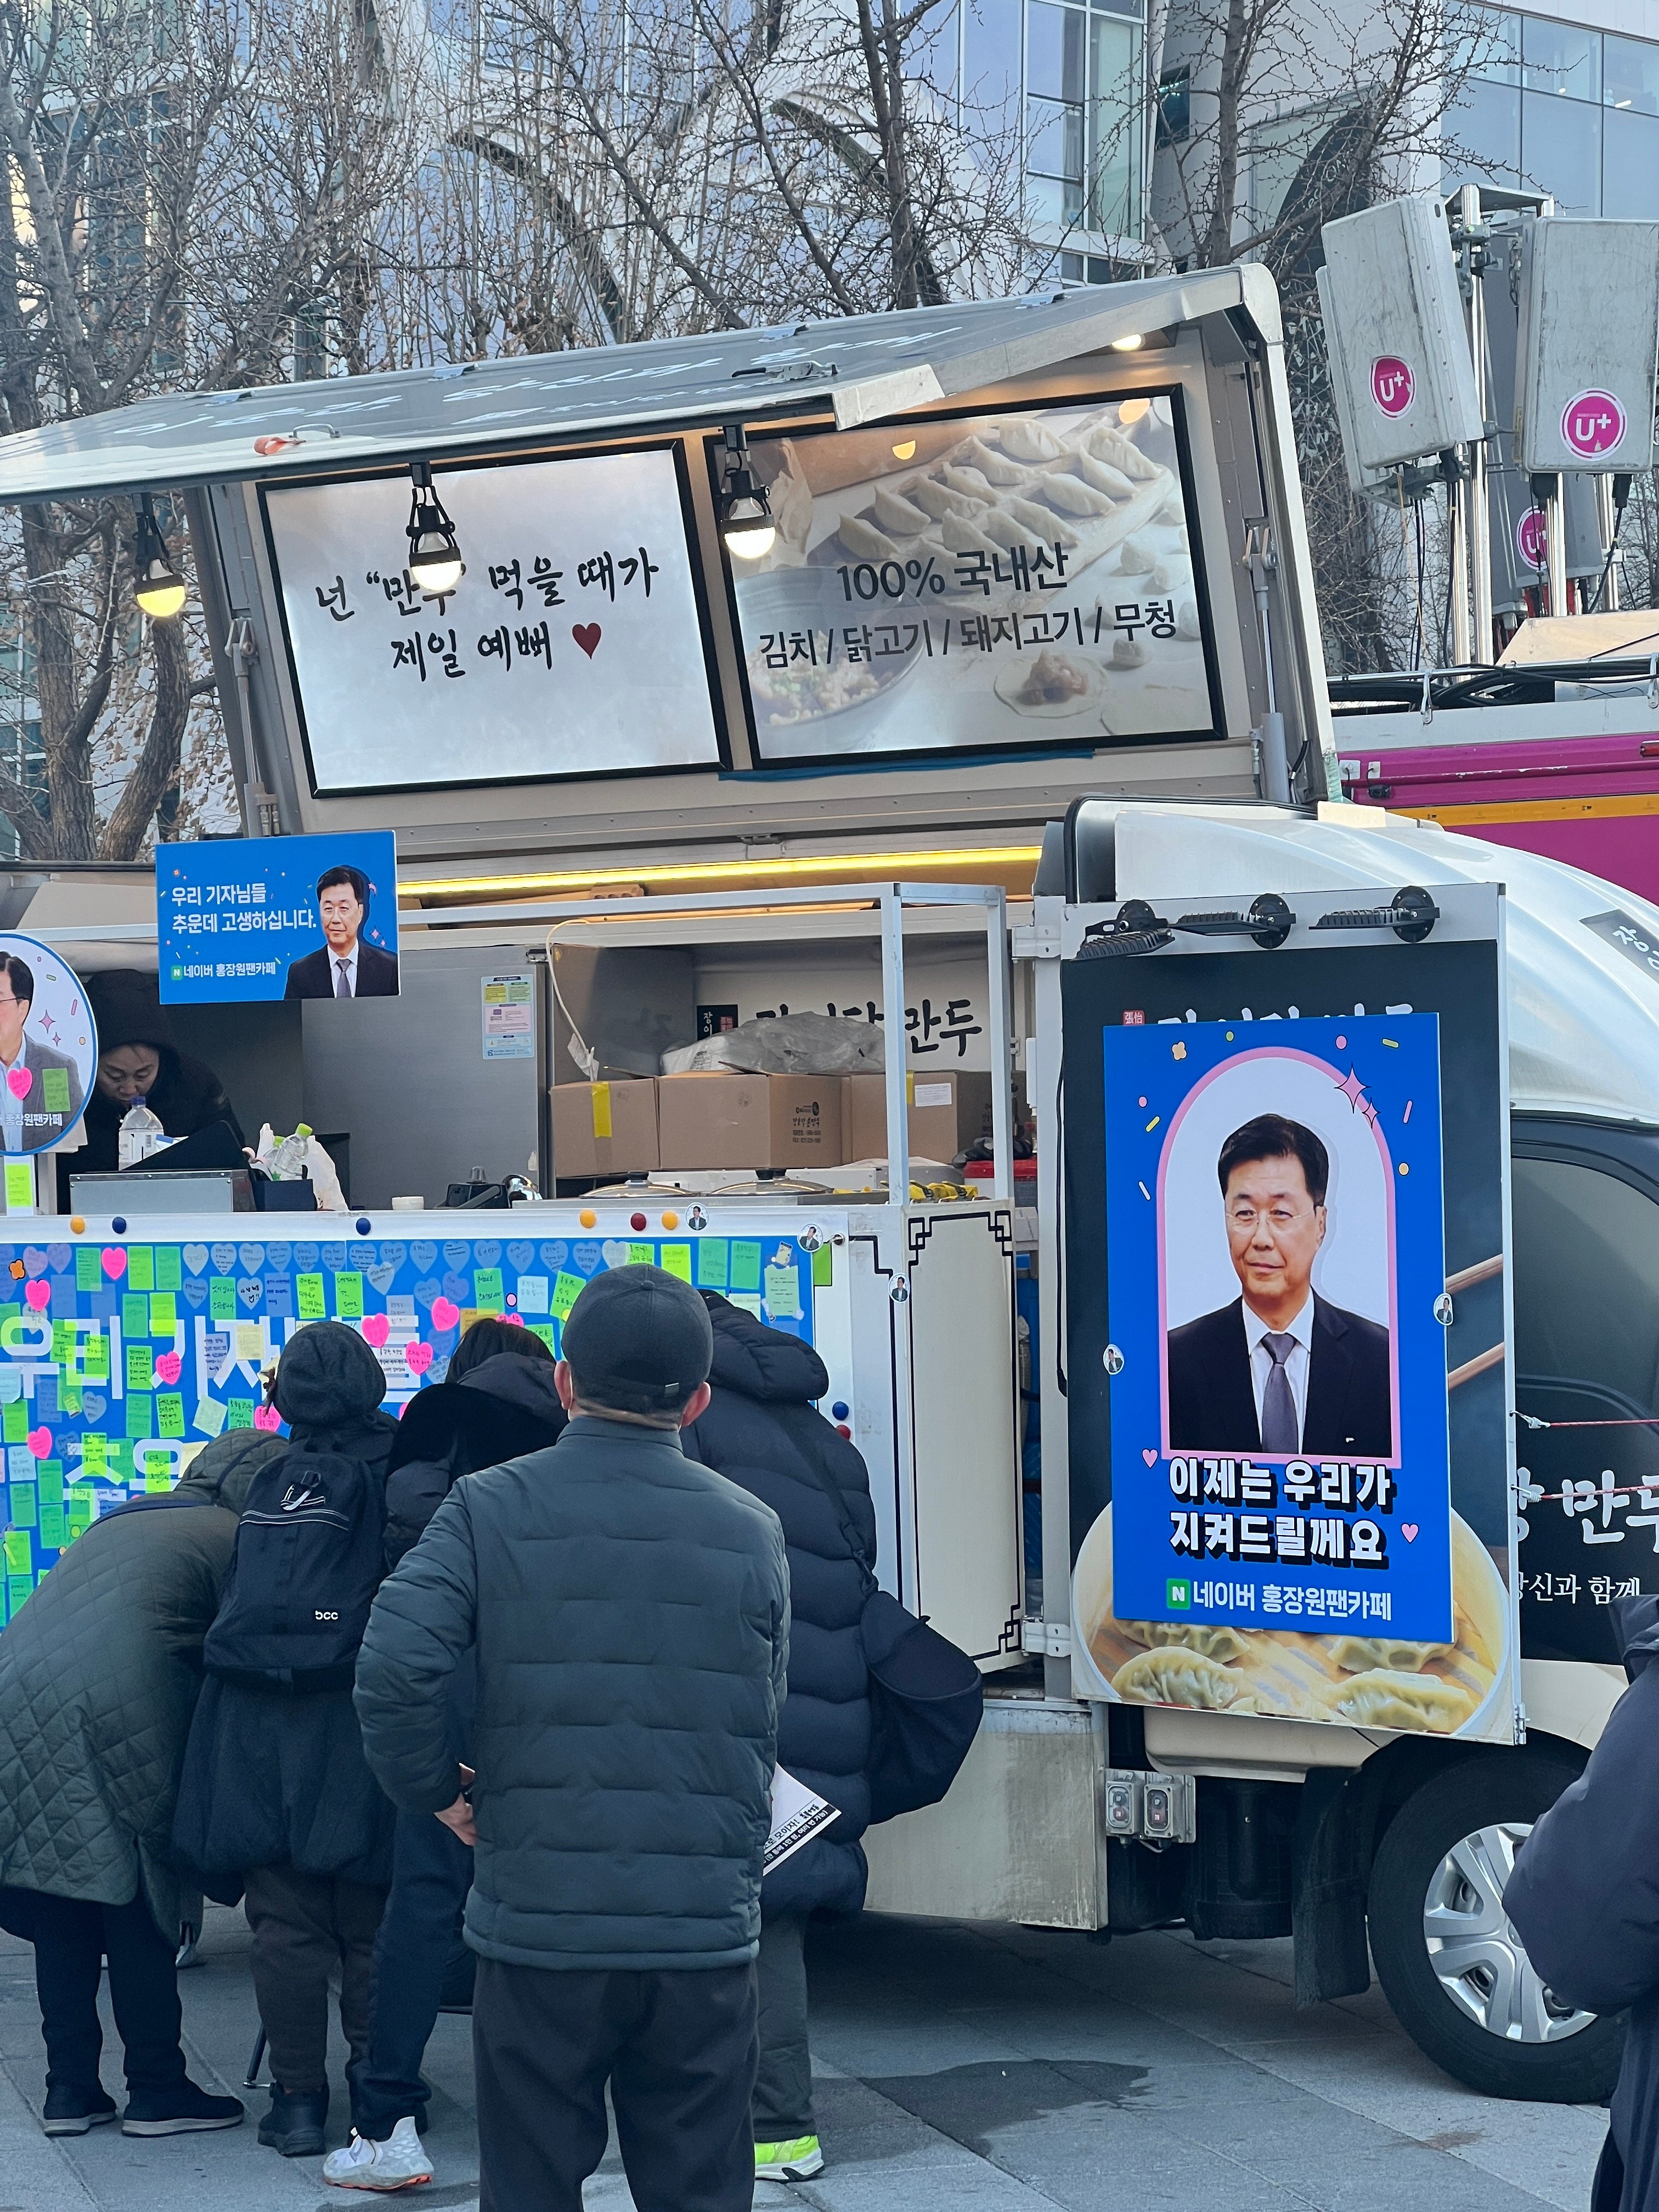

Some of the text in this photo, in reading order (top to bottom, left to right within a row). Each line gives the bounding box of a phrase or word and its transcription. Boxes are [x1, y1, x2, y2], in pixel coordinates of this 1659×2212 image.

[1380, 371, 1404, 402] U+
[1576, 413, 1612, 441] U+
[315, 575, 355, 622] 넌
[489, 555, 566, 610] 먹을
[578, 546, 659, 601] 때가
[837, 542, 1069, 602] 100% 국내산
[759, 628, 819, 669] 김치
[844, 617, 933, 663] 닭고기
[961, 607, 1085, 653] 돼지고기
[1114, 599, 1177, 641] 무청
[391, 621, 552, 682] 제일 예뻐
[171, 882, 267, 907] 우리 기자님들
[172, 908, 317, 934] 추운데 고생하십니다.
[183, 963, 213, 979] 네이버
[216, 961, 276, 977] 홍장원팬카페
[5, 1113, 63, 1127] 홍장원팬카페
[0, 1316, 122, 1400] 우리
[1169, 1457, 1394, 1512] 이제는 우리가
[1169, 1511, 1386, 1566] 지켜드릴께요
[1193, 1581, 1255, 1611] 네이버
[1262, 1583, 1392, 1622] 홍장원팬카페
[1588, 1576, 1640, 1605] 함께
[315, 1610, 338, 1620] bcc
[775, 1819, 800, 1839] 모이자!
